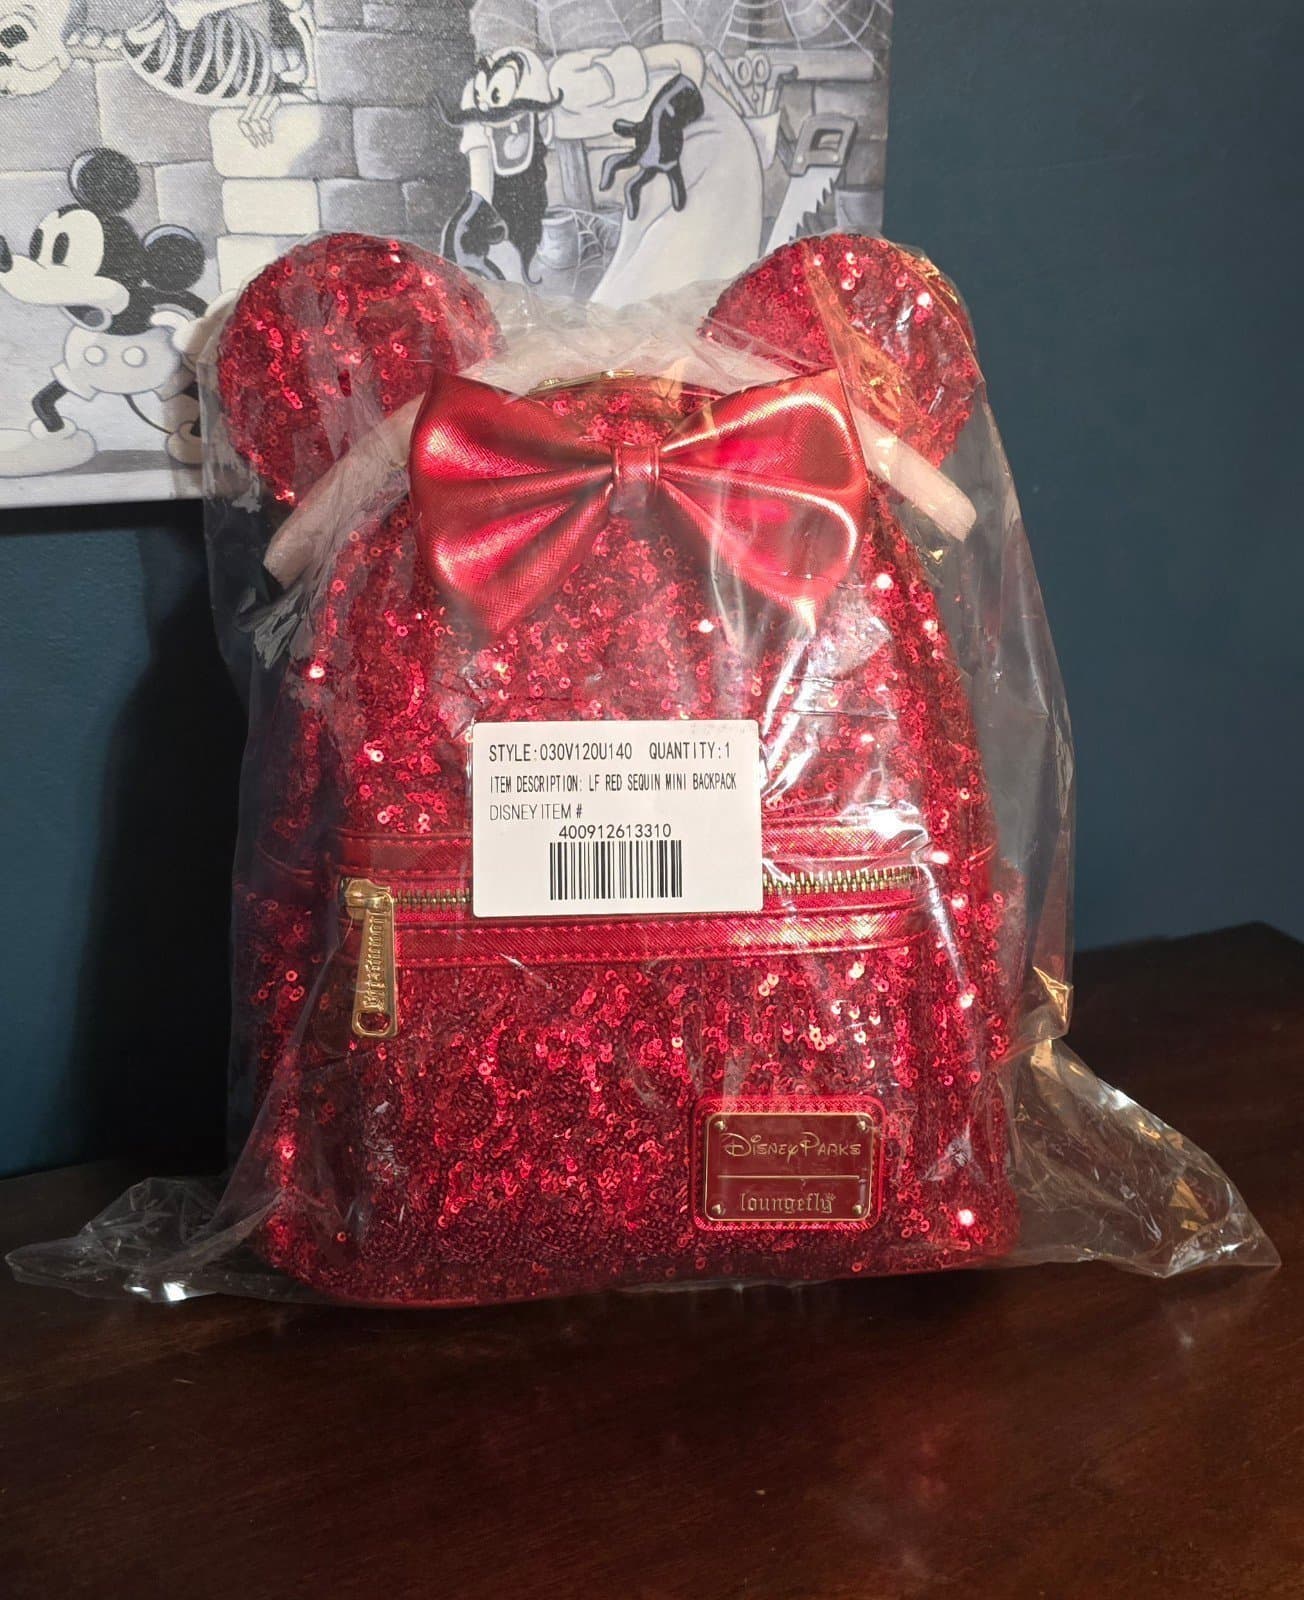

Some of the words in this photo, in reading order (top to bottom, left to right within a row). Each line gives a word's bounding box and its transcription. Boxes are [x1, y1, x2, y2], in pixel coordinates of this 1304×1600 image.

[489, 742, 632, 762] STYLE:030V120U140
[649, 741, 730, 760] QUANTITY:1
[490, 775, 512, 793] ITEM
[516, 774, 582, 793] DESCRIPTION:
[589, 773, 600, 792] LF
[605, 773, 622, 791] RED
[627, 773, 660, 791] SEQUIN
[665, 773, 687, 791] MINI
[692, 772, 736, 790] BACKPACK
[489, 803, 538, 821] DISNEY
[541, 803, 571, 820] ITEM
[575, 803, 583, 819] #
[558, 823, 672, 839] 400912613310
[740, 1192, 836, 1214] loungefly
